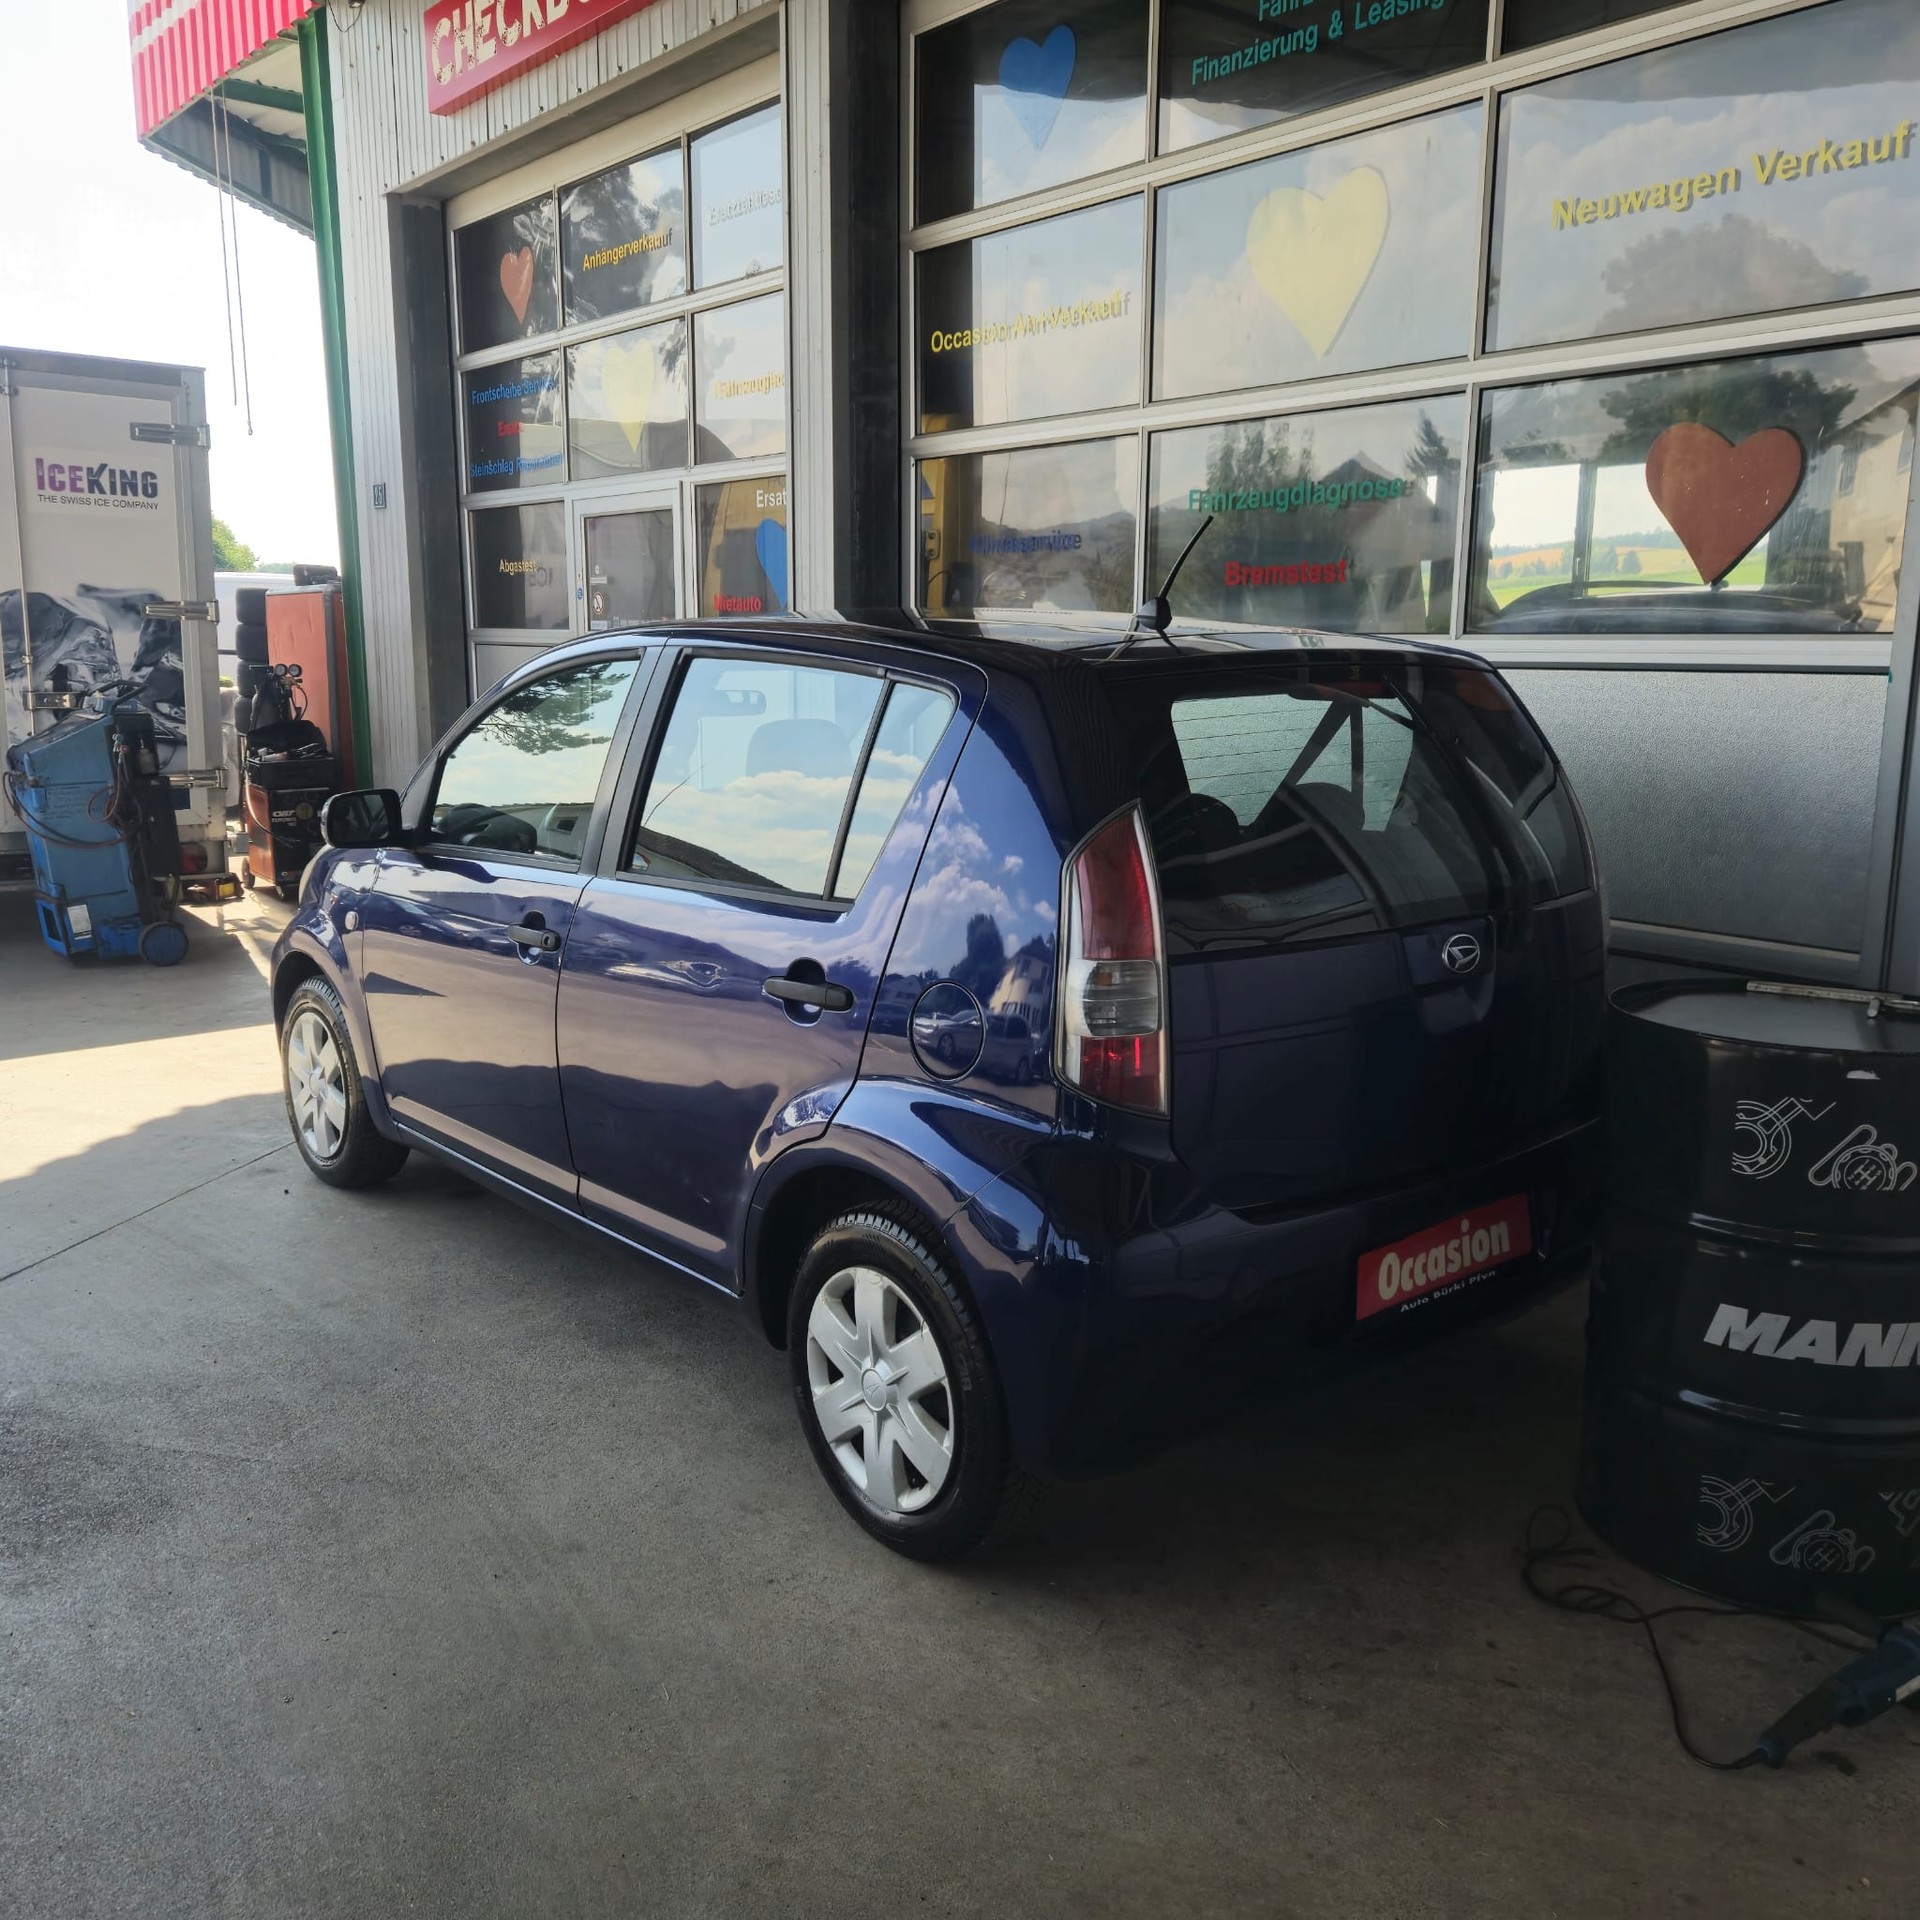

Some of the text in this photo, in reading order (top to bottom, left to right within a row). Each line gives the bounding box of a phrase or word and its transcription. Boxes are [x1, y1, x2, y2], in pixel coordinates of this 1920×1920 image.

[431, 0, 592, 86] CHECK
[1192, 23, 1318, 86] Finanzierung
[1328, 9, 1344, 41] &
[1551, 119, 1913, 230] Neuwagen Verkauf
[582, 227, 673, 272] Anhängerverkauf
[931, 322, 1009, 354] Occasion
[471, 382, 521, 405] Frontscheibe
[470, 457, 514, 478] Steinschlag
[38, 494, 159, 511] THE SWISS ICE COMPANY
[1189, 478, 1408, 513] Fahrzeugdiagnose
[499, 558, 539, 577] Abgastest
[1225, 556, 1350, 587] Bremstest
[1378, 1218, 1511, 1301] Occasion
[1400, 1297, 1430, 1313] Auto
[1433, 1280, 1466, 1299] Bürki
